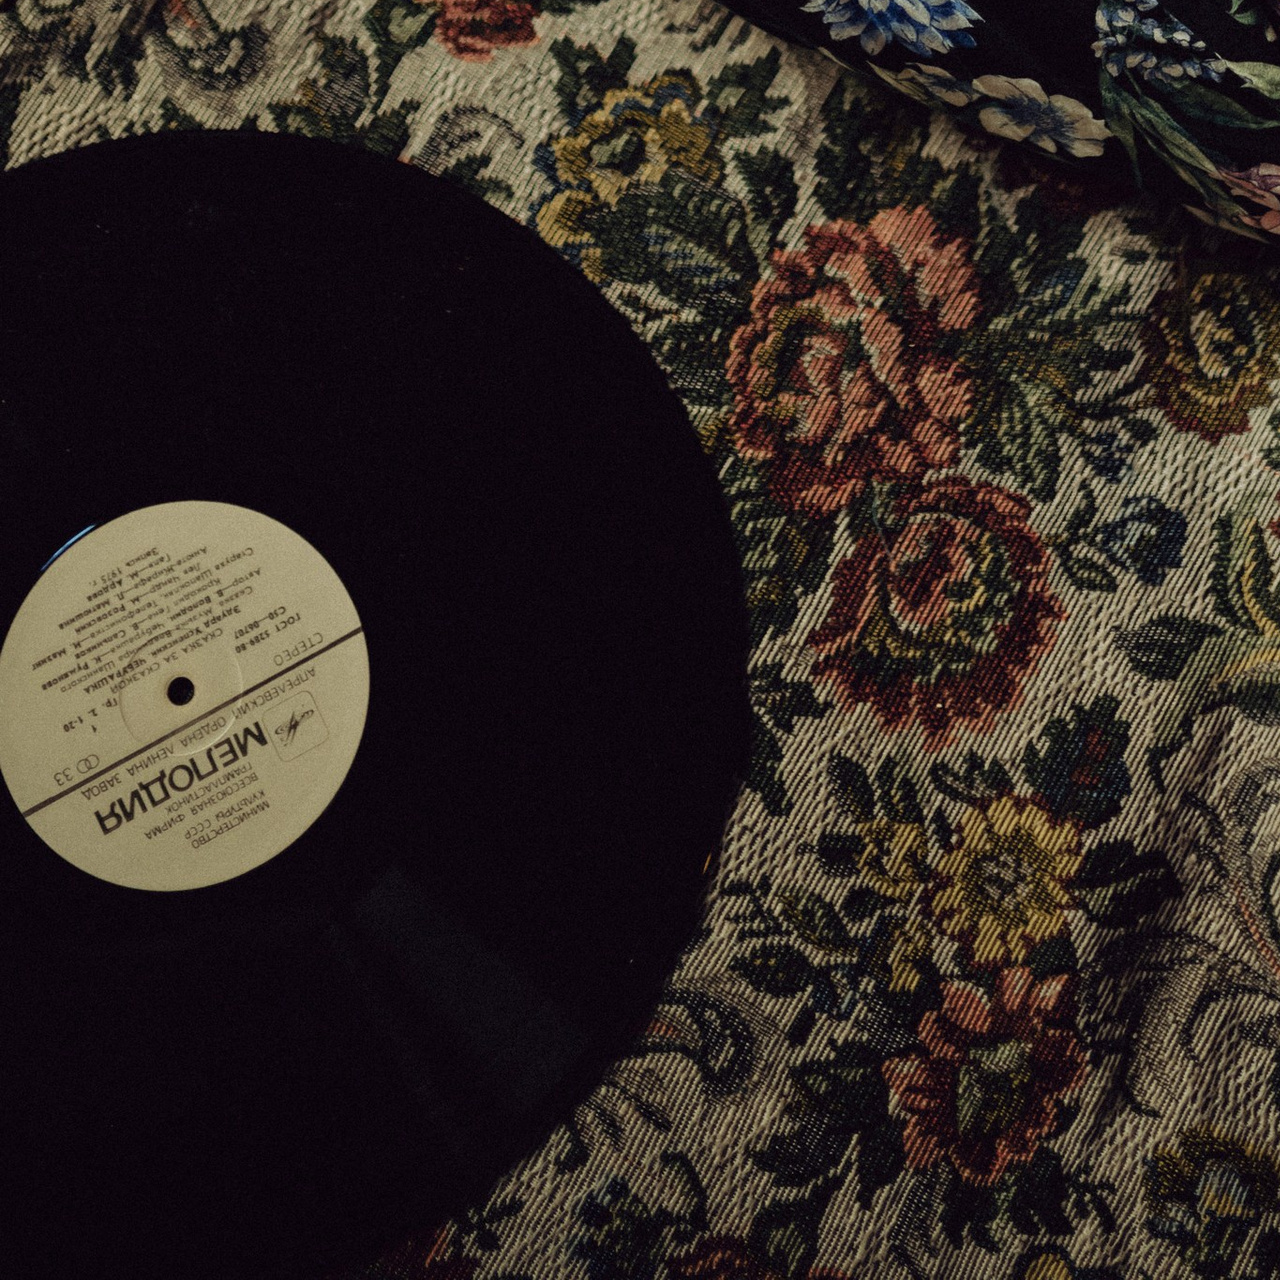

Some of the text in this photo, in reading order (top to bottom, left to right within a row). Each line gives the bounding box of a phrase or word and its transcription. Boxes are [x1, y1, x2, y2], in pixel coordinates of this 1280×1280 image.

[100, 566, 123, 585] 1975
[124, 546, 159, 569] Запись
[214, 546, 255, 573] Старуха
[86, 577, 124, 603] Ардова
[172, 576, 221, 607] Крокодил
[202, 604, 242, 630] Эдуард
[234, 612, 301, 655] ГОСТ 5289-80
[180, 626, 224, 655] СКАЗКА
[272, 631, 325, 667] СТЕРЕО
[82, 656, 147, 695] ЧЕБУРАШКА
[109, 661, 161, 695] СКАЗКОЙ
[80, 666, 317, 802] АПРЕЛЕВСКИЙ ОРДЕНА ЛЕНИНА ЗАВОД
[91, 720, 271, 836] МЕЛОДИЯ
[164, 761, 253, 815] ГРАМПЛАСТИНОК
[143, 772, 259, 841] ВСЕСОЮЗНАЯ ФИРМА
[183, 788, 267, 841] КУЛЬТУРЫ СССР
[190, 800, 271, 849] МИНИСТЕРСТВО
